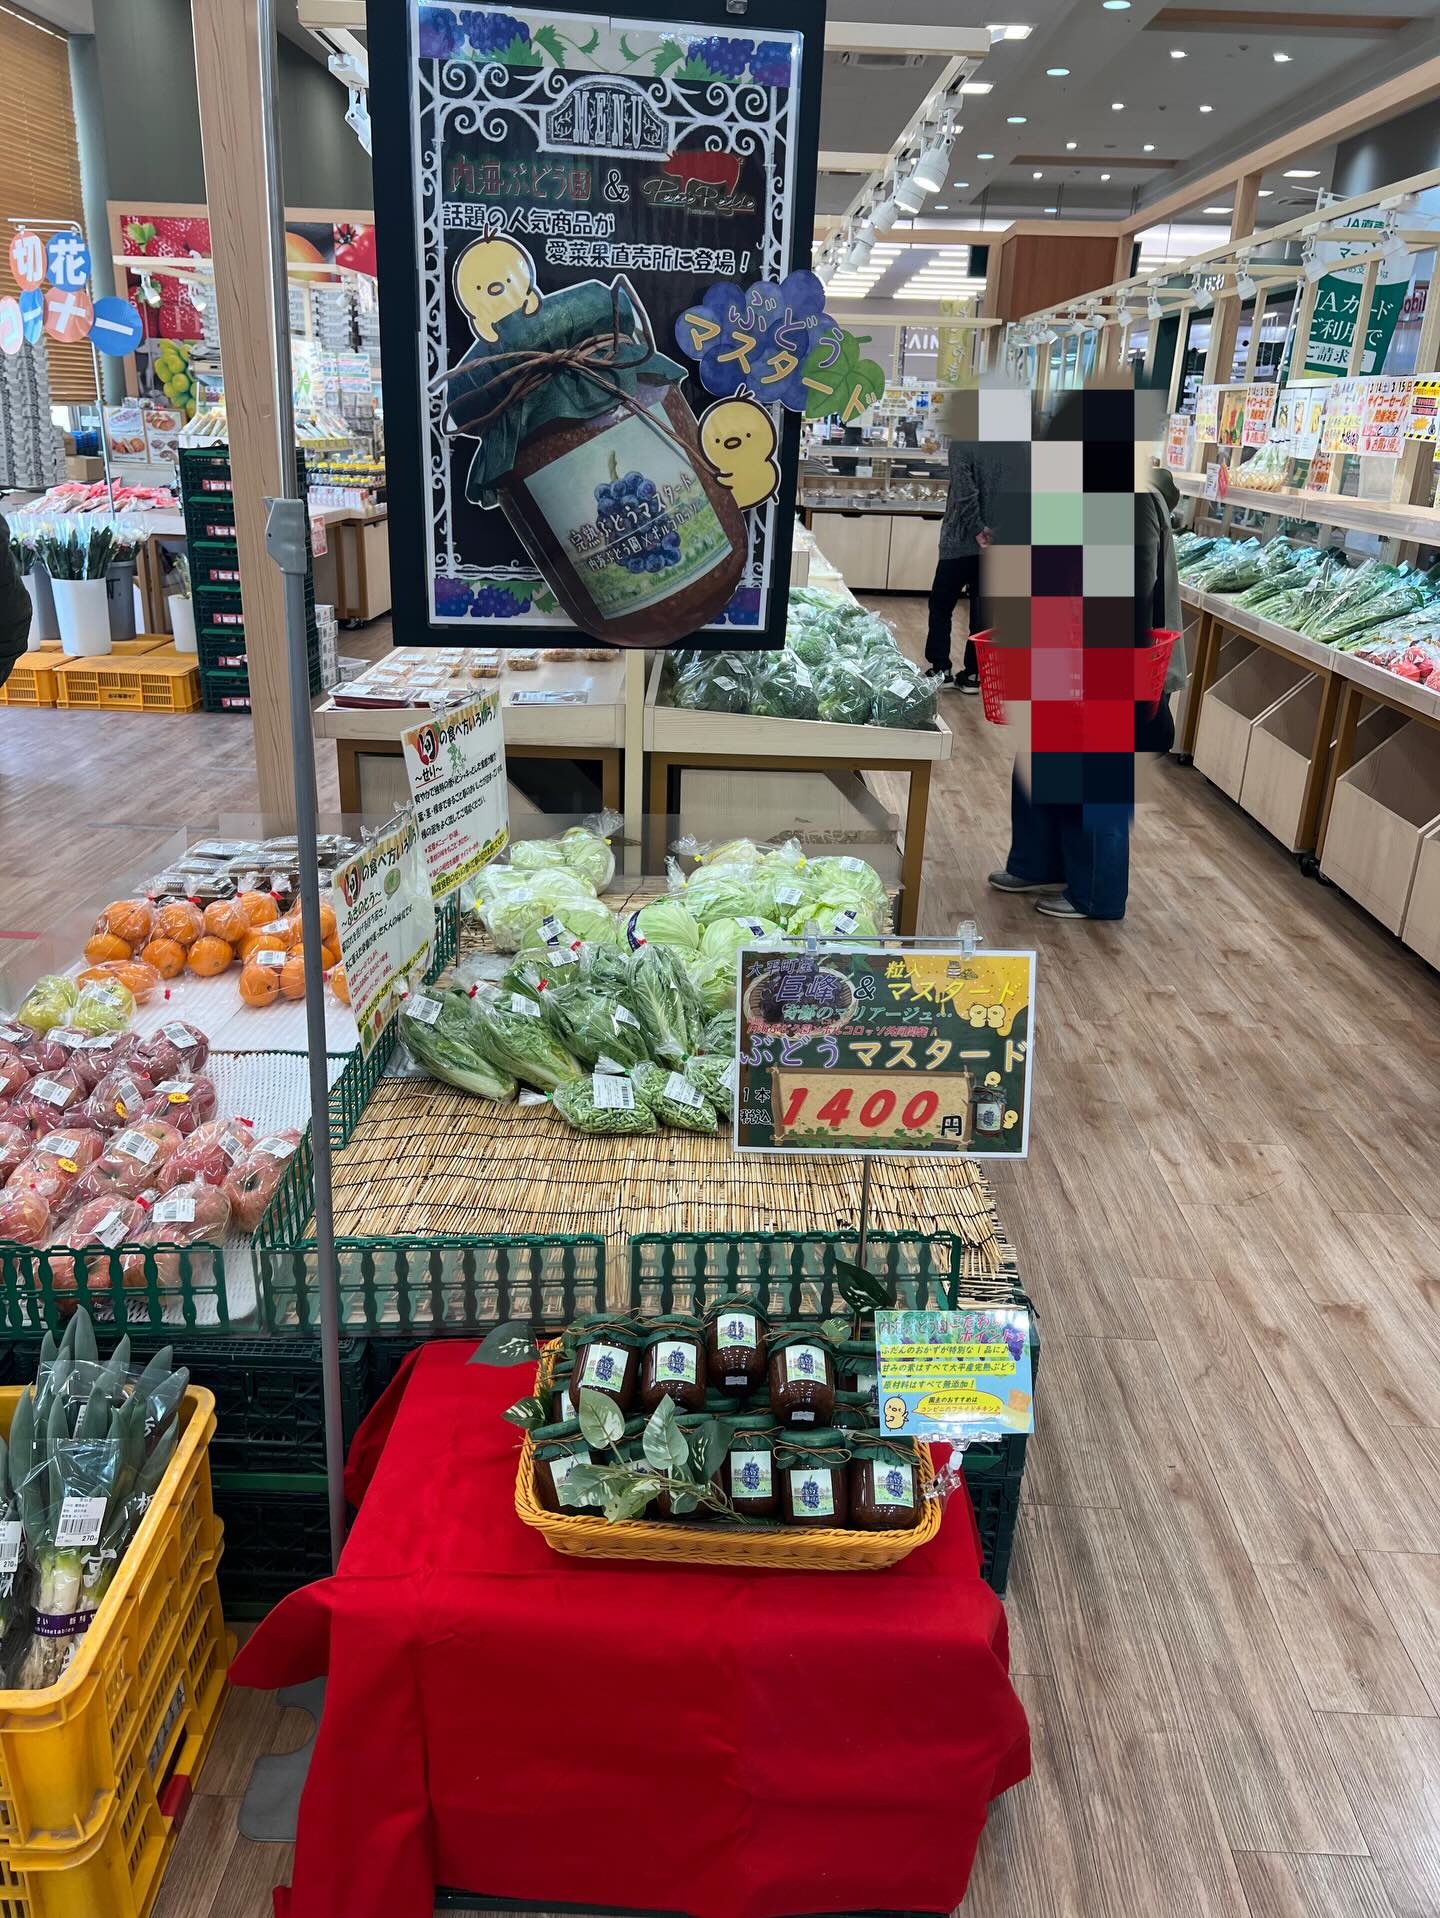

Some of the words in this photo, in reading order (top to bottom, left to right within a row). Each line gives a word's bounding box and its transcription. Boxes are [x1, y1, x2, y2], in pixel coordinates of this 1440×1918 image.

[573, 89, 644, 149] MENU
[604, 170, 629, 202] &
[442, 203, 615, 237] 話題の人気商品が
[12, 236, 87, 285] 切花
[546, 240, 751, 275] 愛菜果直売所に登場！
[1313, 289, 1394, 322] JAカド
[728, 289, 844, 369] ぶどう
[684, 313, 878, 422] マスタード
[569, 471, 694, 554] 完熟ぶどうマスタード
[775, 974, 838, 1002] 巨峰
[853, 976, 876, 1000] &
[887, 980, 1023, 1004] マスタード
[740, 1108, 772, 1126] 税込
